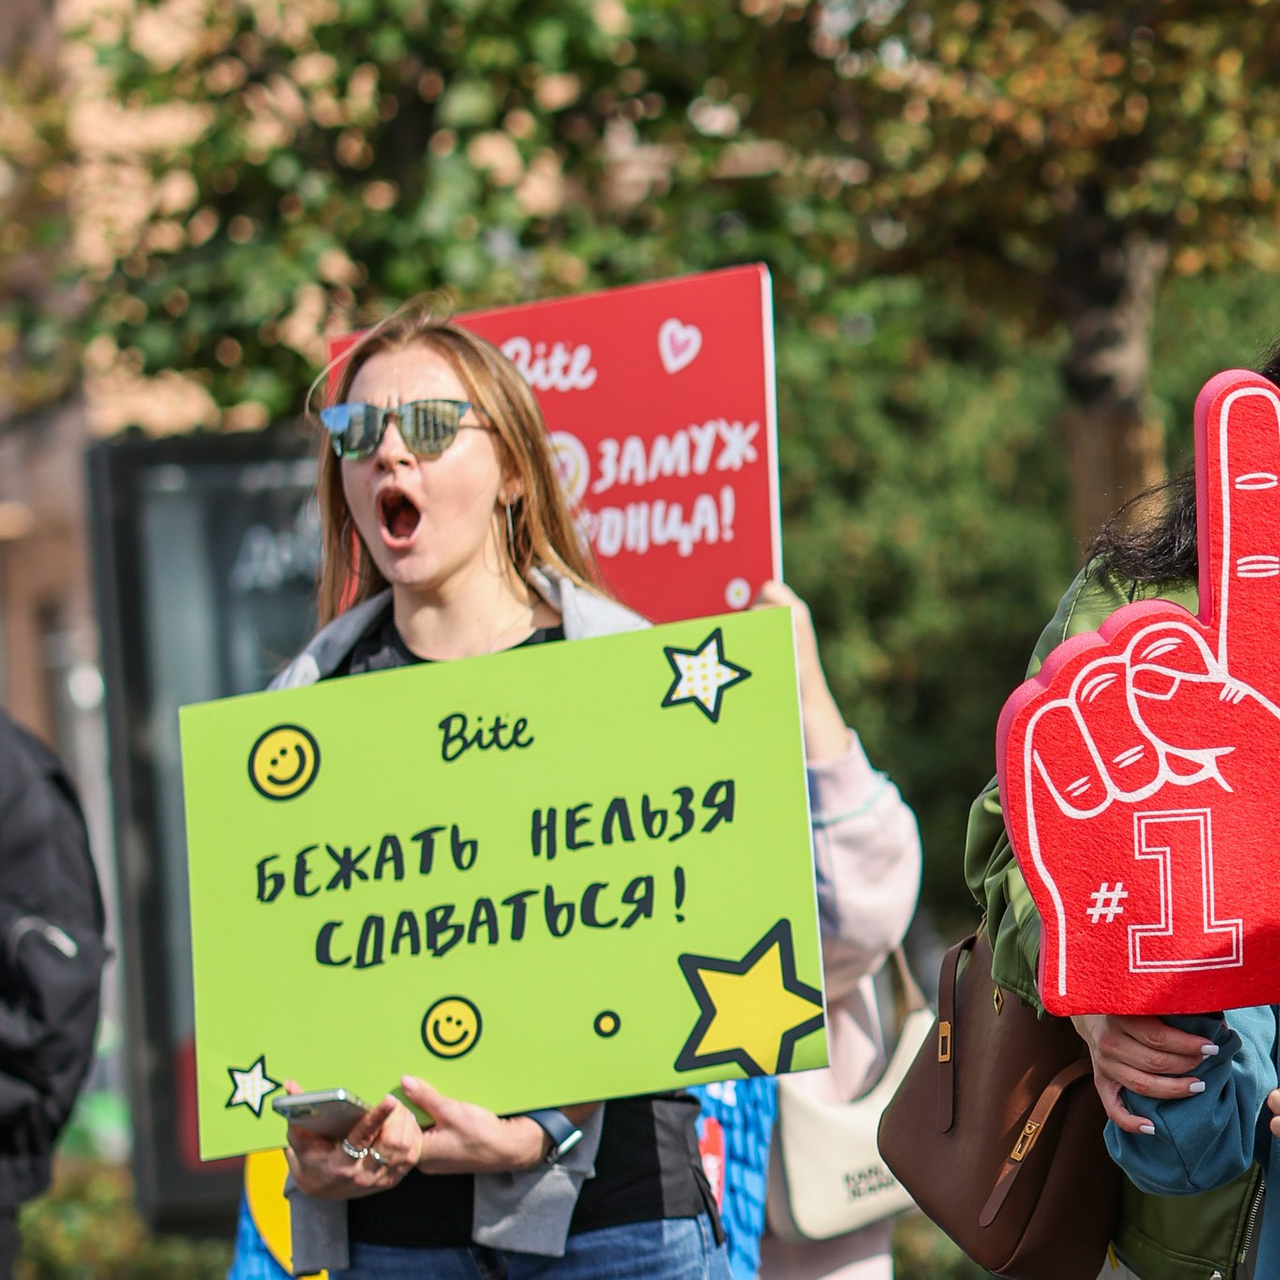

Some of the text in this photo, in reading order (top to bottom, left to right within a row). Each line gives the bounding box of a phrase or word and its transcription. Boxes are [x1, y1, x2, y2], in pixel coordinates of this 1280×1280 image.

[592, 419, 760, 495] ЗАМУЖ
[438, 713, 534, 763] Bite
[256, 780, 736, 904] БЕЖАТЬ НЕЛЬЗЯ
[1086, 808, 1244, 974] #1
[316, 866, 686, 970] СДАВАТЬСЯ!
